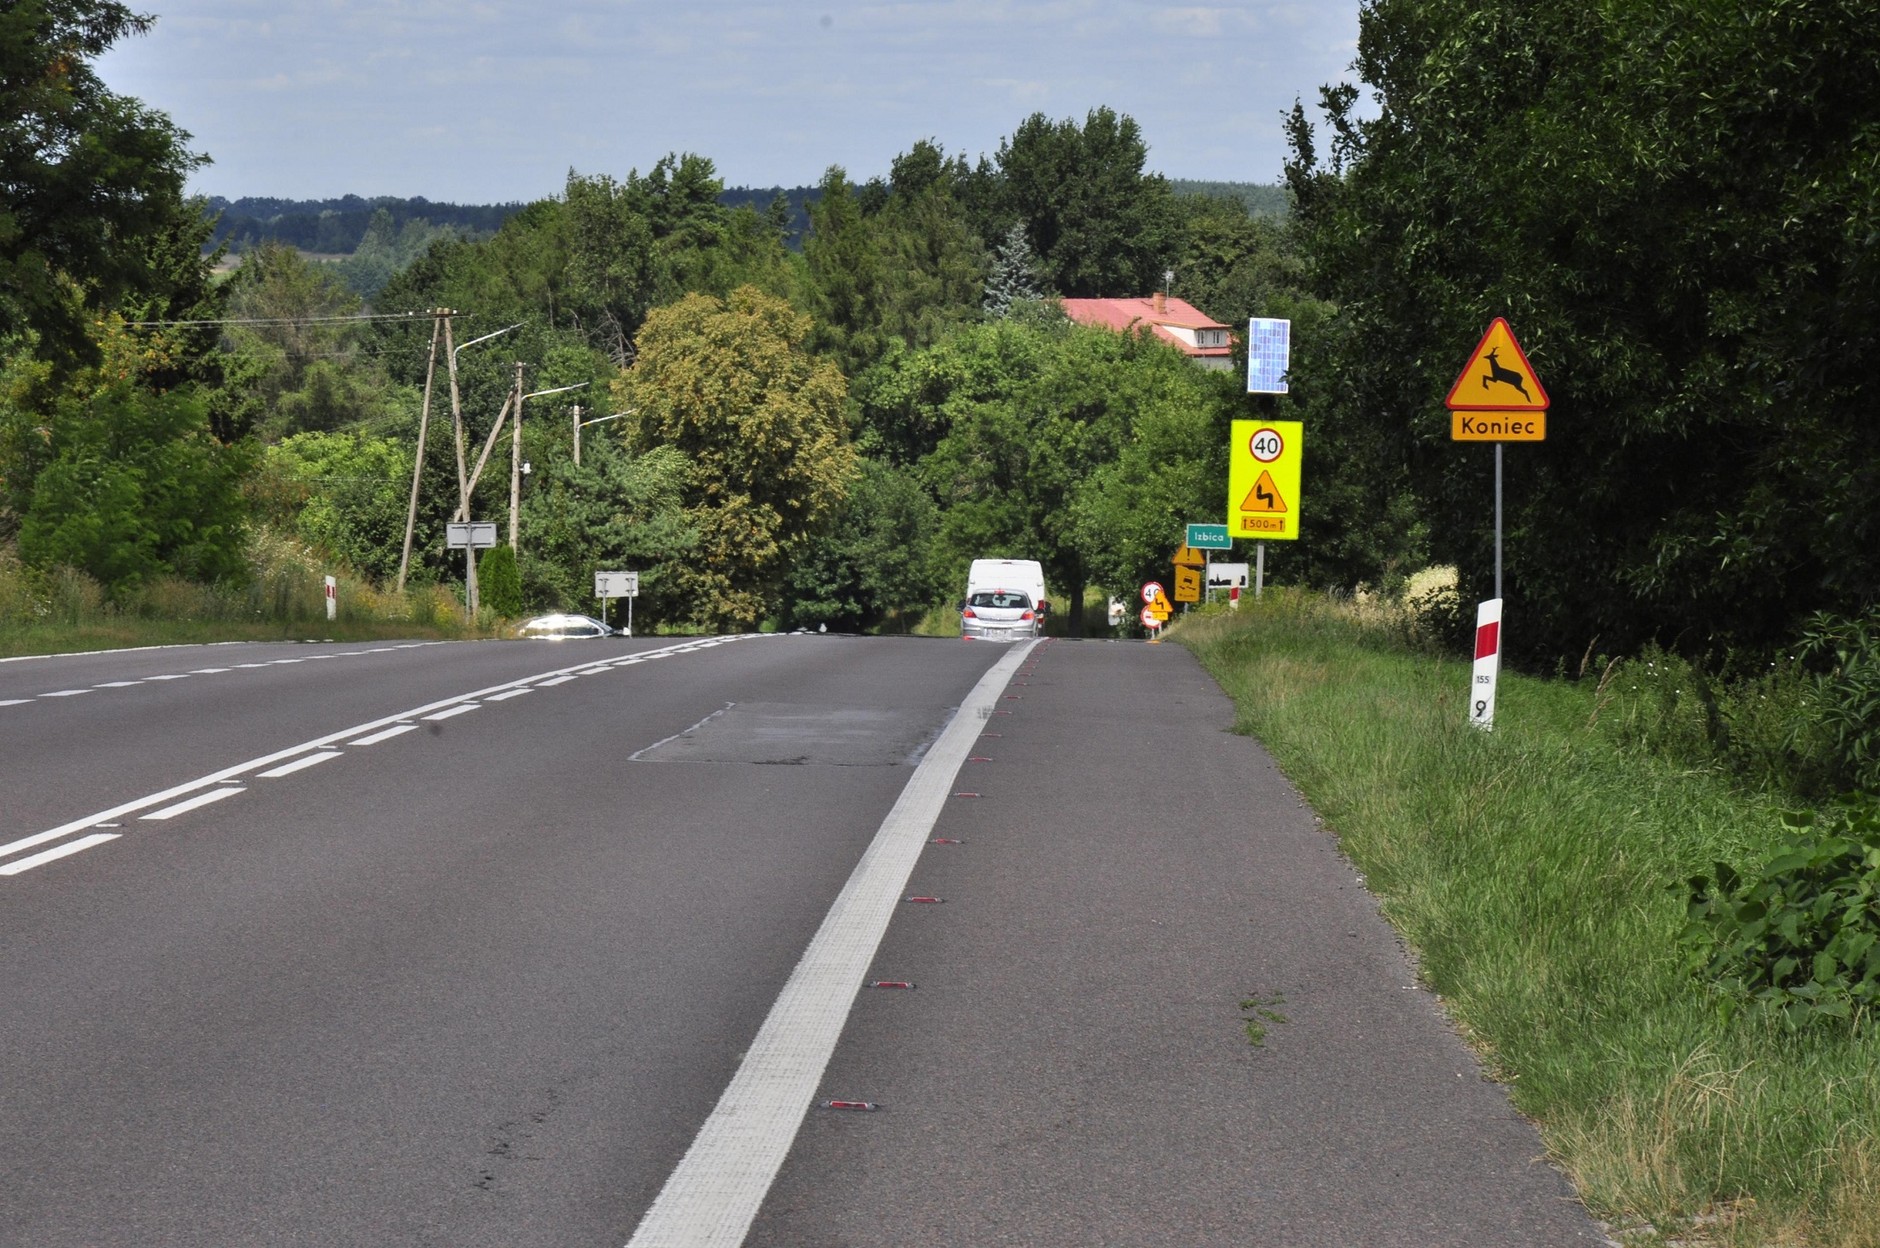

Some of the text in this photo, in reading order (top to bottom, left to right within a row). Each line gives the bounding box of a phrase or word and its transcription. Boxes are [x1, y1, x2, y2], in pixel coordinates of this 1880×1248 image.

[1462, 417, 1534, 434] Koniec
[1255, 437, 1278, 454] 40
[1250, 520, 1269, 528] 500
[1194, 532, 1224, 541] Izbica
[1477, 676, 1489, 684] 155
[1476, 700, 1486, 717] 9
